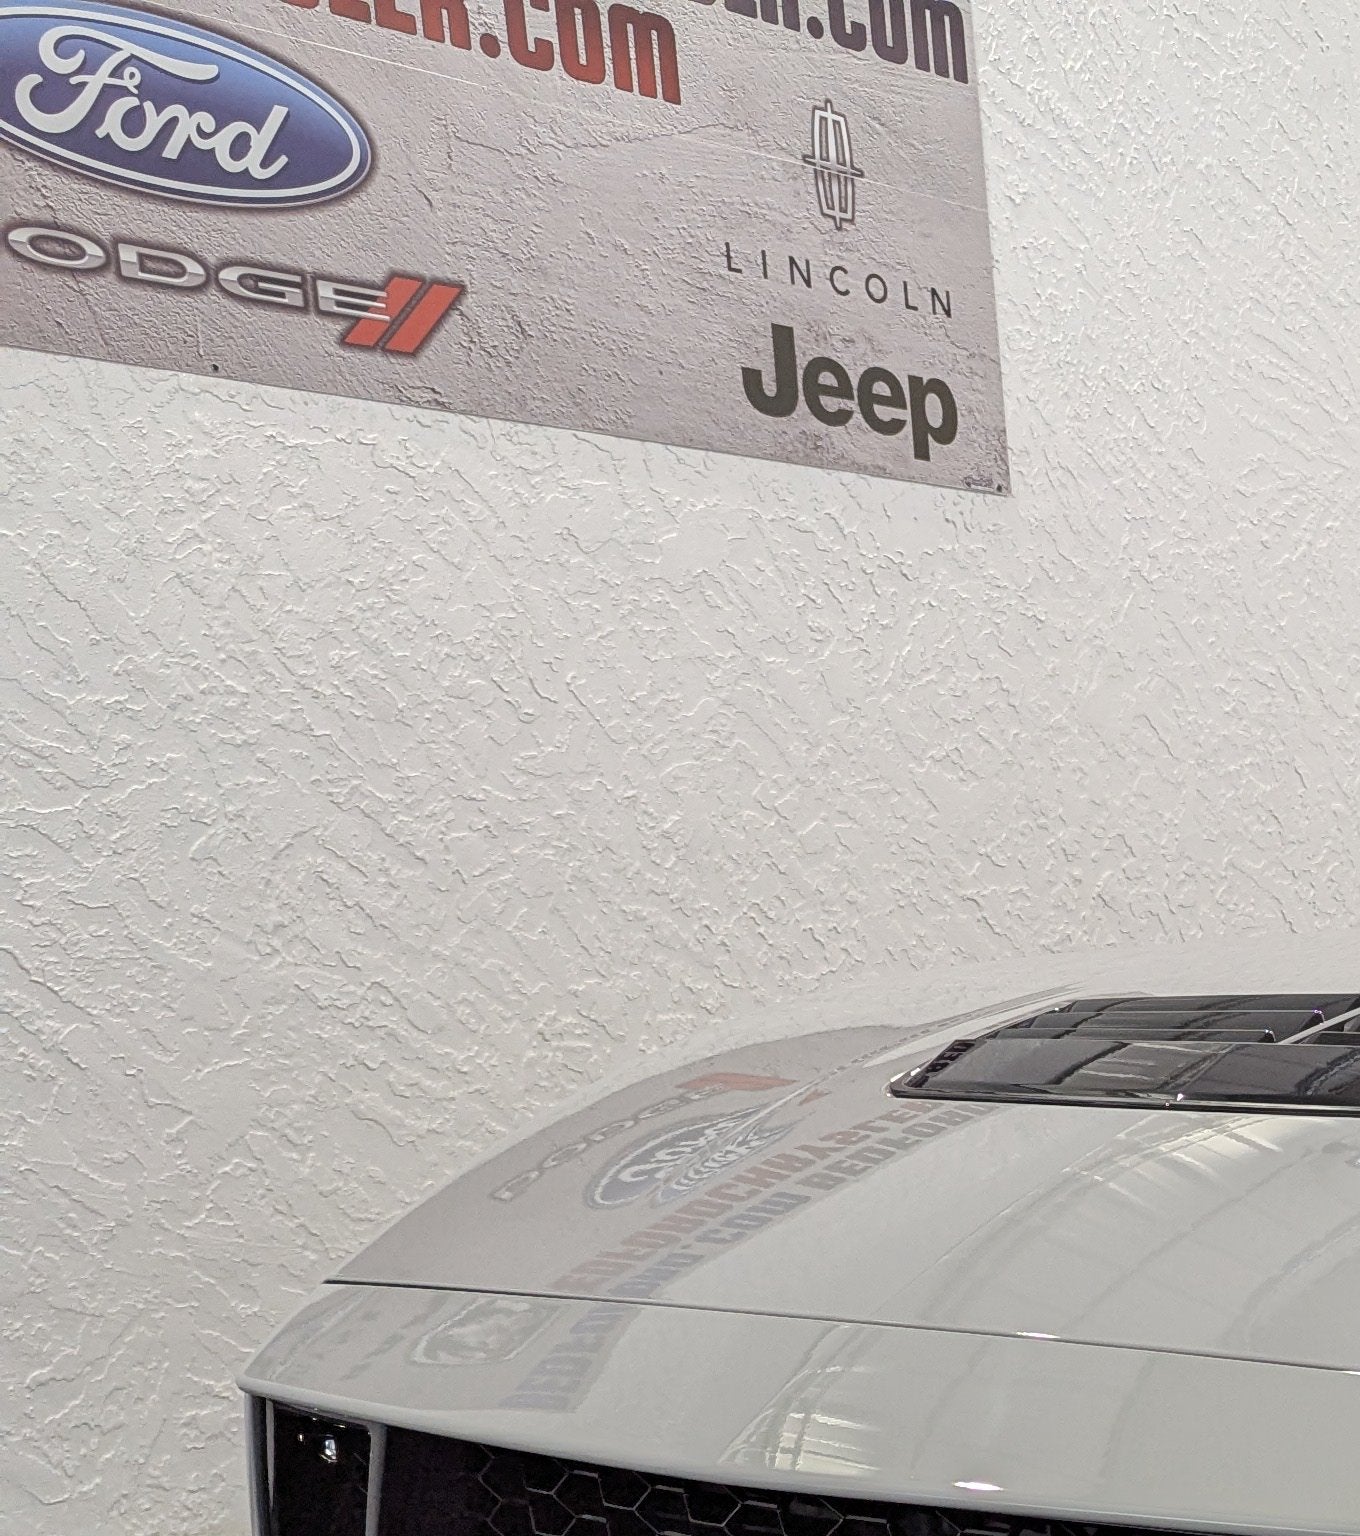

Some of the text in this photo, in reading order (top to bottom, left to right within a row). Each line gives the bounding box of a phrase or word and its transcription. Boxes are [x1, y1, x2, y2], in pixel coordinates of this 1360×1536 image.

[14, 25, 290, 180] Ford
[724, 241, 952, 319] LINCOLN
[741, 322, 959, 462] Jeep
